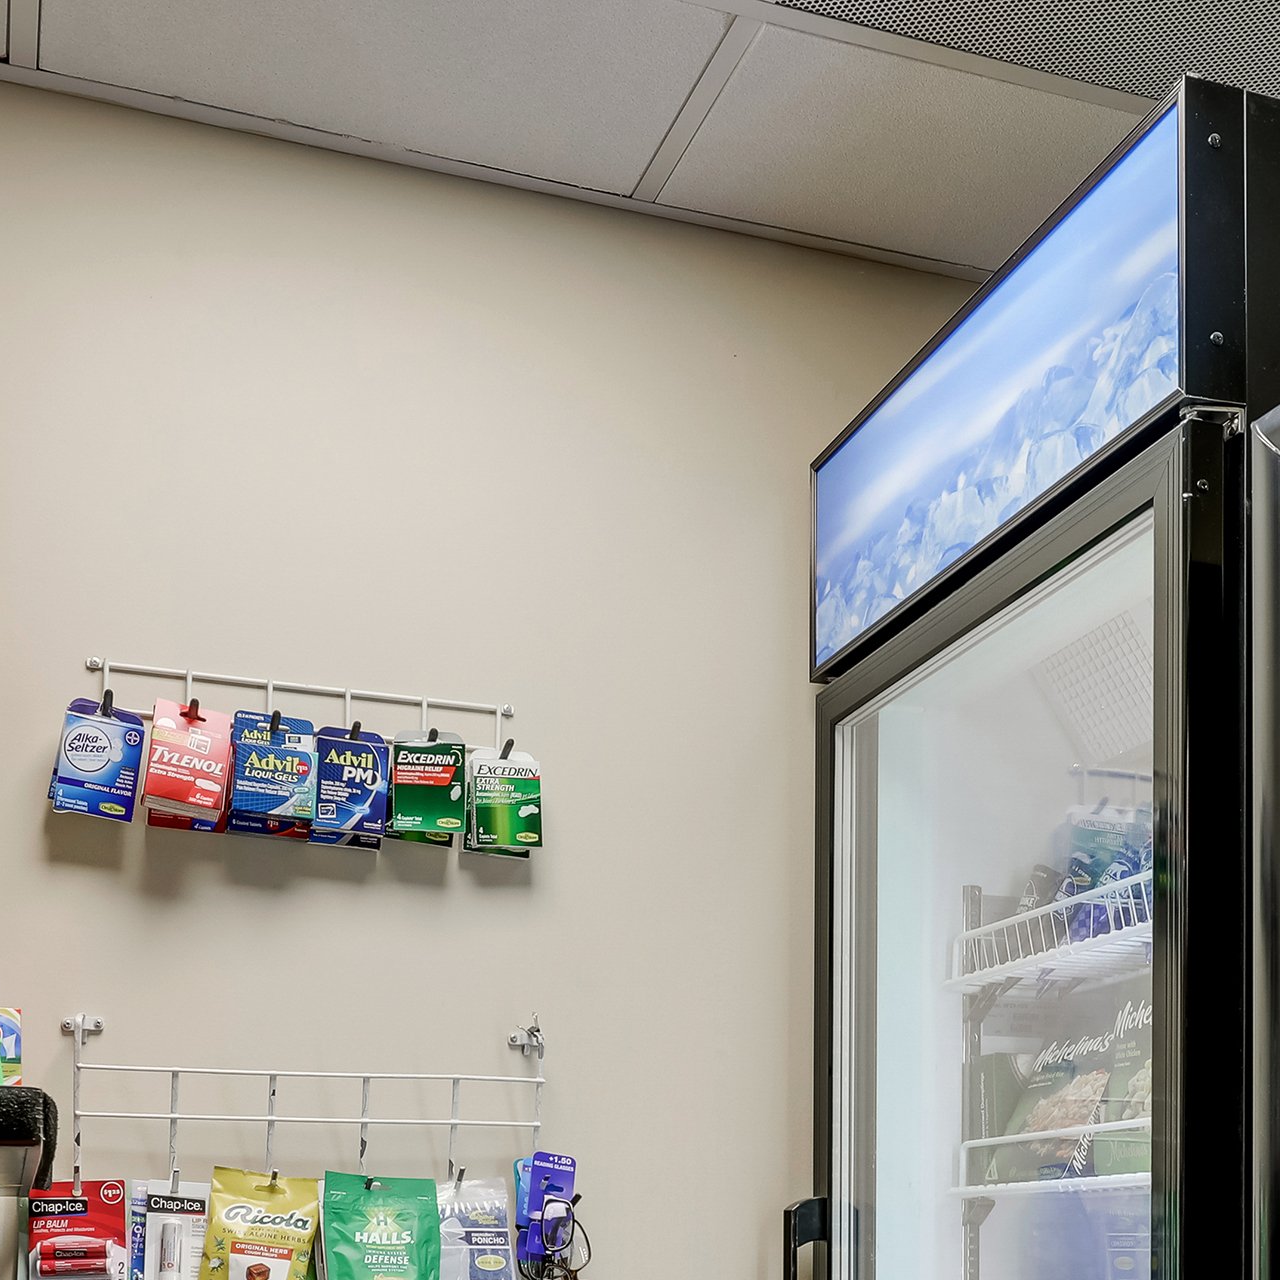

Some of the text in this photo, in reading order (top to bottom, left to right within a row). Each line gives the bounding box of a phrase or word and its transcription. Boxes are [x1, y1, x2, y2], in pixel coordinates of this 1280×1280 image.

[71, 731, 103, 744] Alka-
[67, 741, 109, 754] Seltzer
[151, 745, 225, 776] TYLENOL
[243, 750, 300, 775] Advil
[324, 747, 374, 770] Advil
[396, 750, 456, 766] EXCEDRIN
[244, 767, 299, 783] LIQUI-GELS
[342, 766, 375, 784] PM
[476, 763, 539, 778] EXCEDRIN
[475, 777, 500, 785] EXTRA
[475, 783, 515, 792] STRENGTH
[32, 1218, 69, 1229] LIP BALM
[224, 1204, 311, 1231] Ricola
[471, 1236, 505, 1246] PONCHO
[235, 1242, 289, 1255] ORIGINAL HERB
[364, 1253, 410, 1265] DEFENSE
